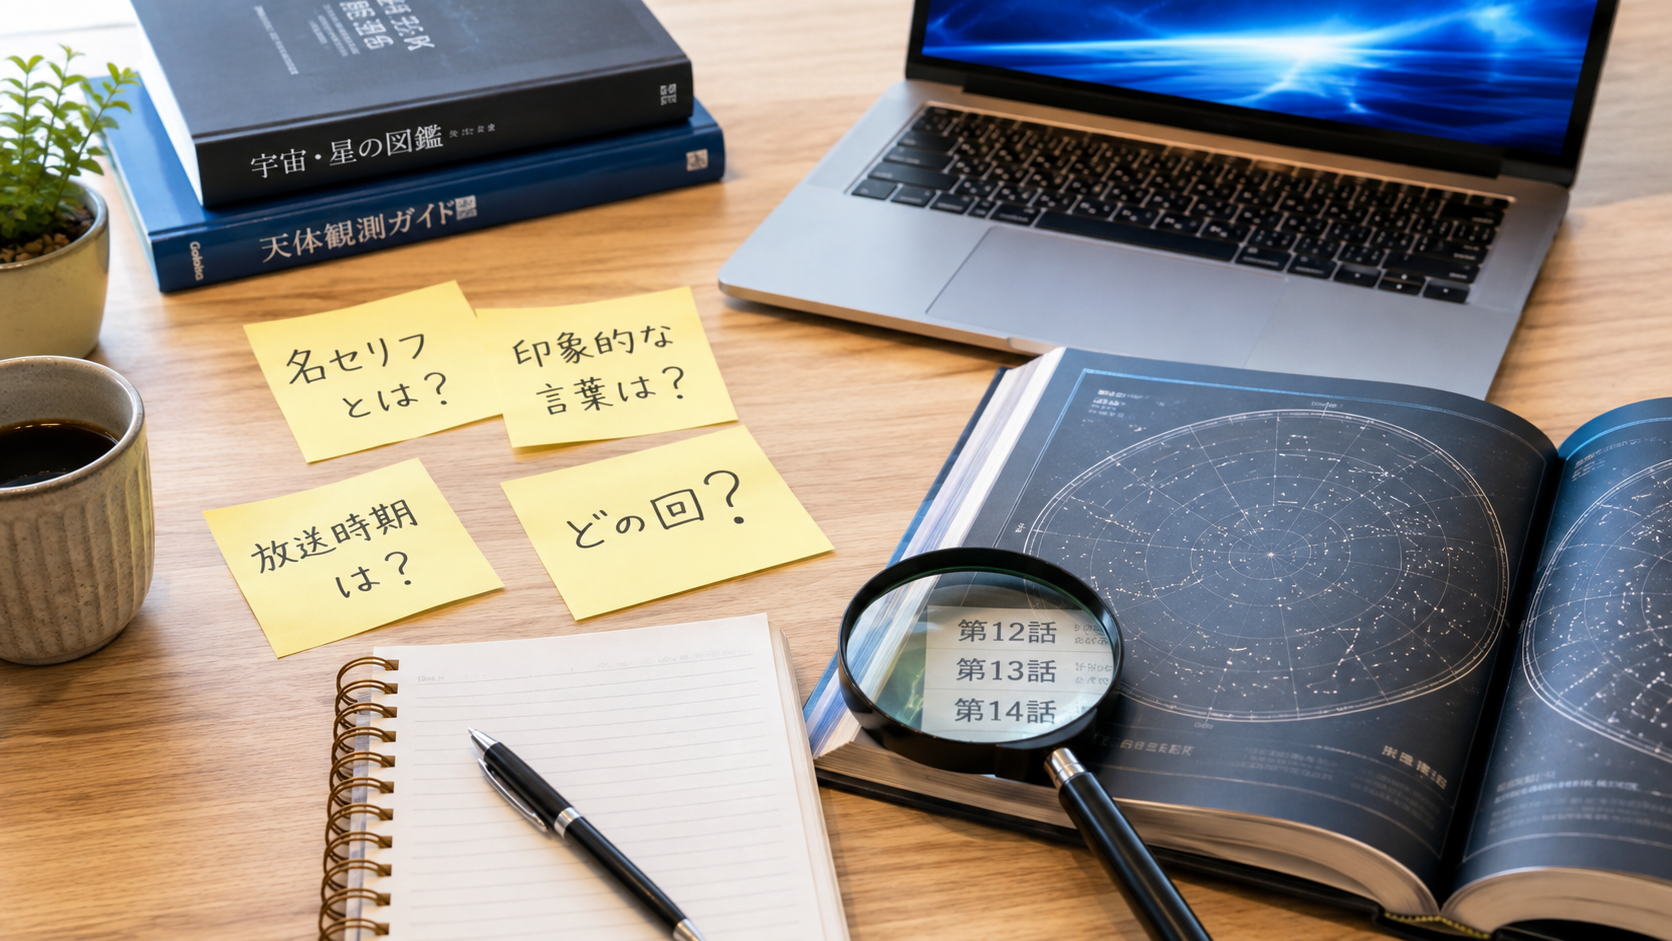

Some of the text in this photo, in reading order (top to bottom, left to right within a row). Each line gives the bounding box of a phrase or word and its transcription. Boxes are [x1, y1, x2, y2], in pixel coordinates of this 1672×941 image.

[250, 124, 443, 178] 宇宙・星の図鑑
[259, 199, 454, 262] 天体観測ガイド
[286, 333, 426, 385] 名セリフ
[512, 325, 674, 369] 印象的な
[342, 371, 448, 418] とは？
[536, 365, 685, 415] 言葉は？
[566, 469, 745, 549] どの回？
[250, 499, 419, 574] 放送時期
[335, 550, 412, 598] は？
[957, 618, 1058, 644] 第12話
[956, 657, 1058, 683] 第13話
[954, 697, 1058, 724] 第14話
